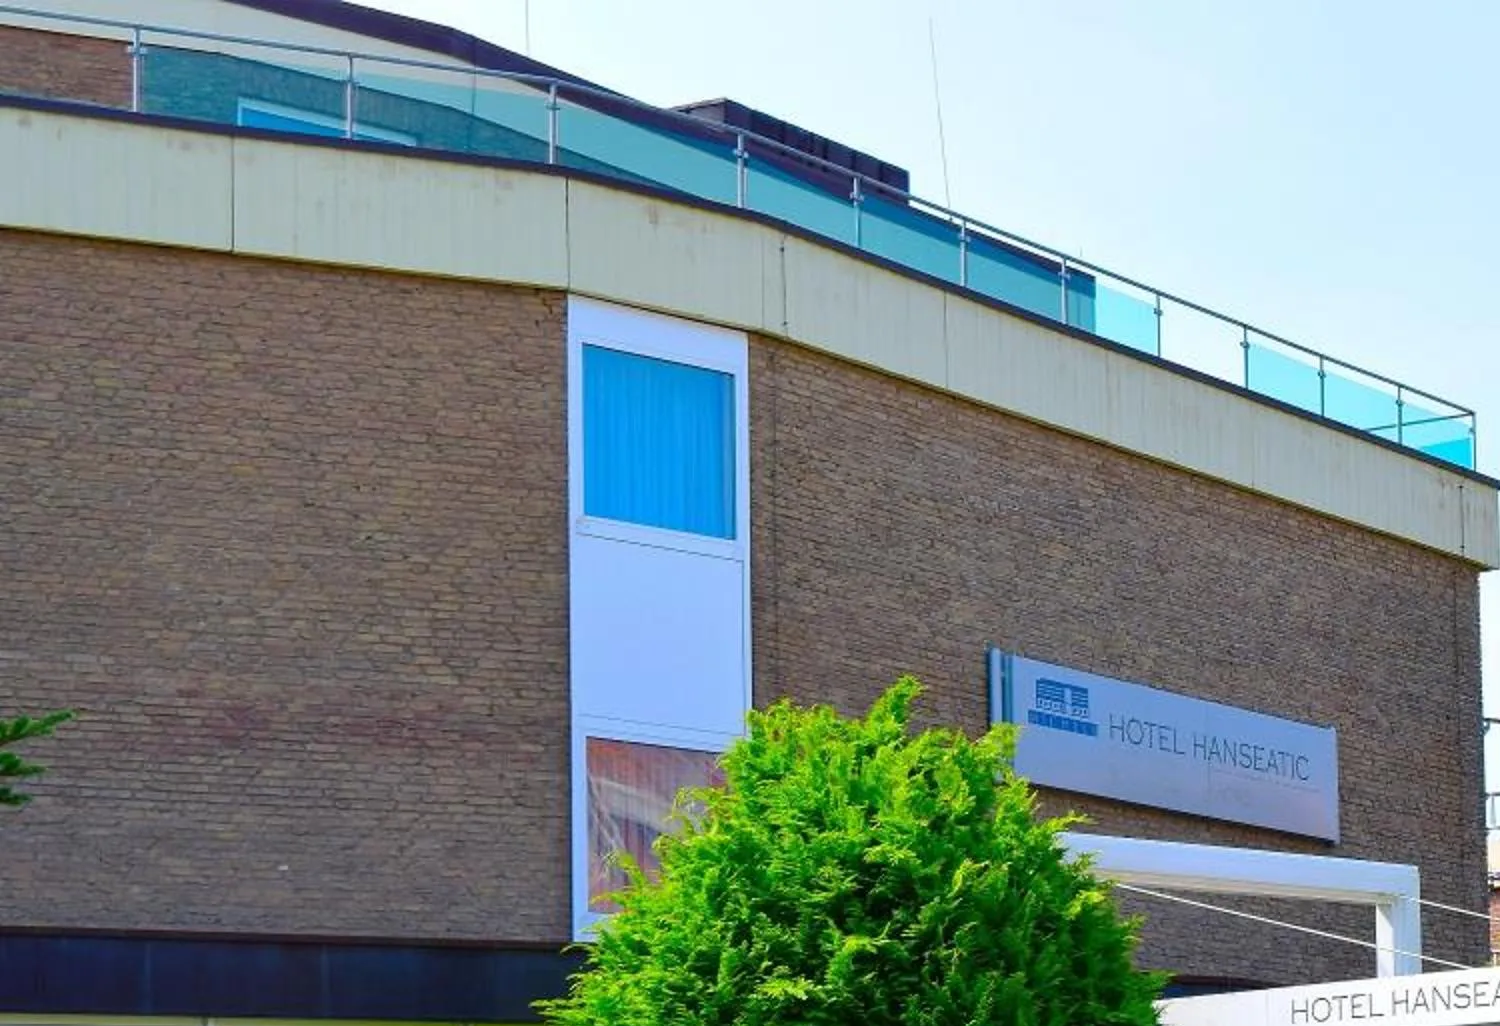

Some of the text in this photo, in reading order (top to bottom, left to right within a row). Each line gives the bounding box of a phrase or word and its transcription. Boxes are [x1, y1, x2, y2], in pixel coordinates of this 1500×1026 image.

[1109, 714, 1186, 756] HOTEL
[1192, 734, 1310, 781] HANSEATIC
[1291, 993, 1385, 1024] HOTEL
